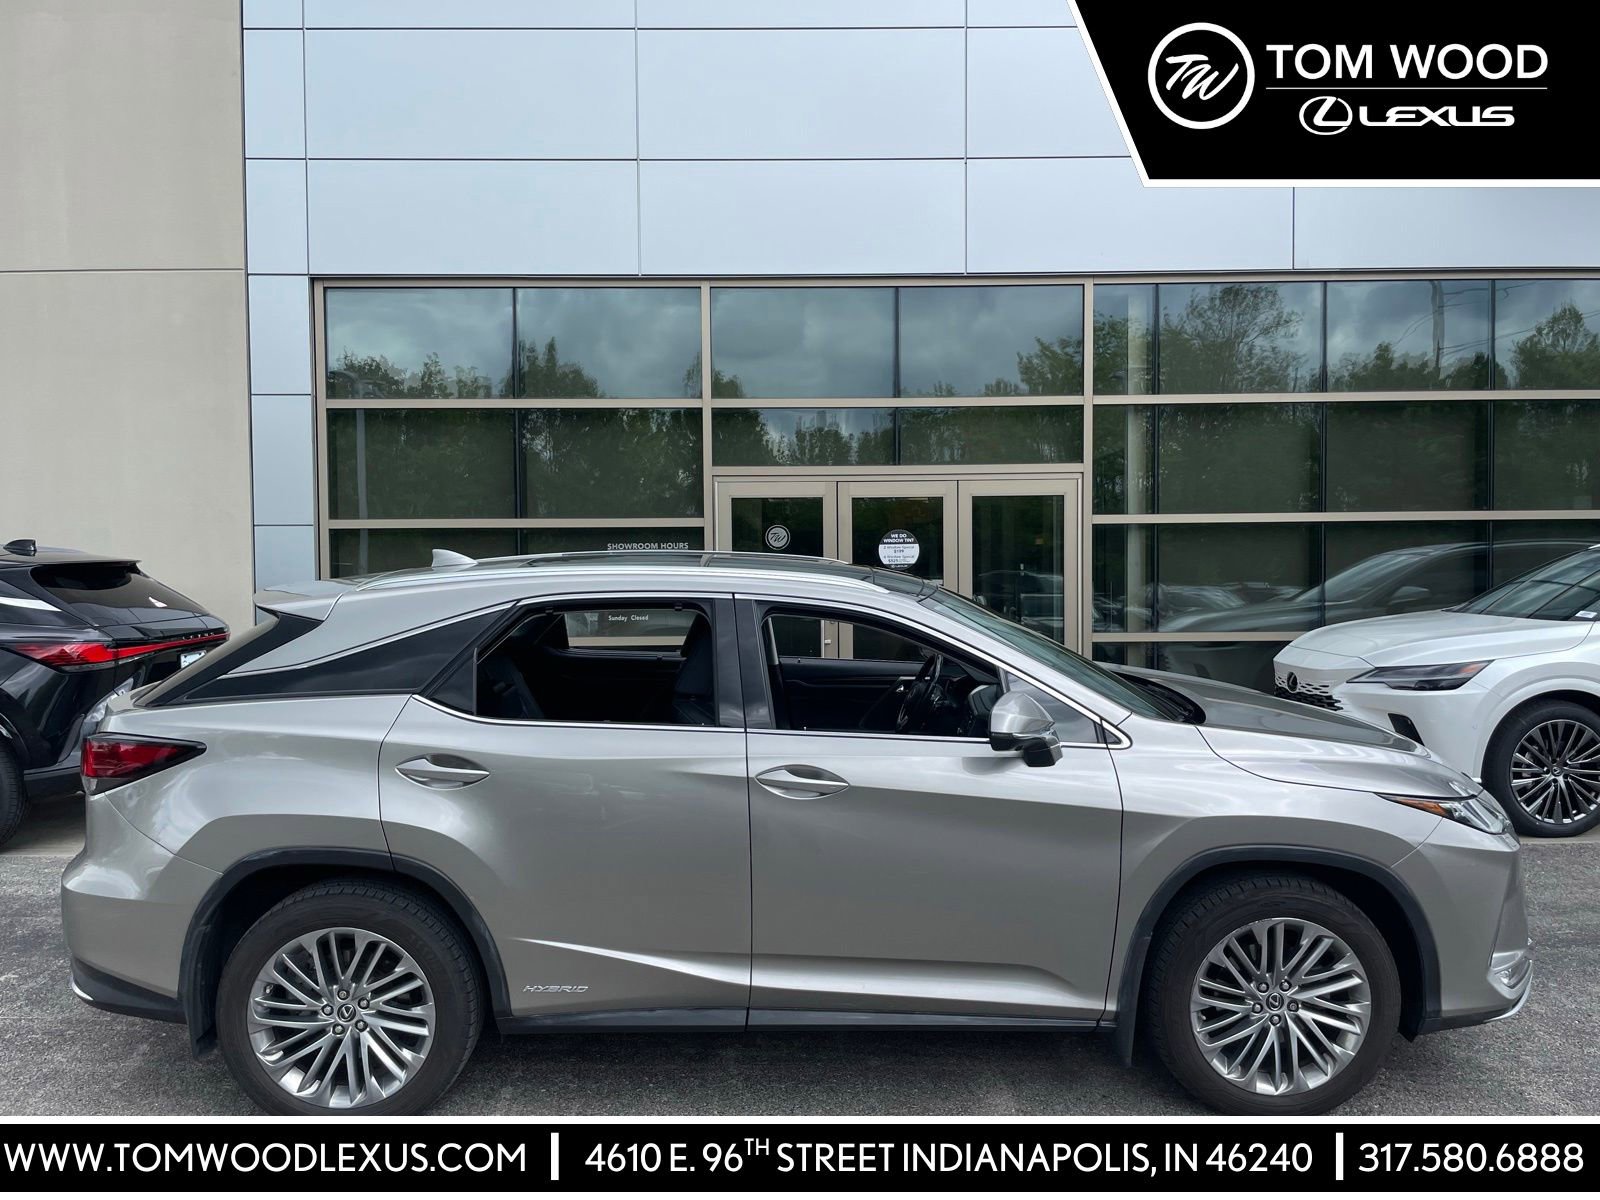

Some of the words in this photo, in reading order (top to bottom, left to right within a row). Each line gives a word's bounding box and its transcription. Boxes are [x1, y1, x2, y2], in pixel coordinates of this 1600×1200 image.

[607, 542, 659, 551] SHOWROOM
[660, 542, 689, 550] HOURS
[522, 985, 589, 993] HYBRID
